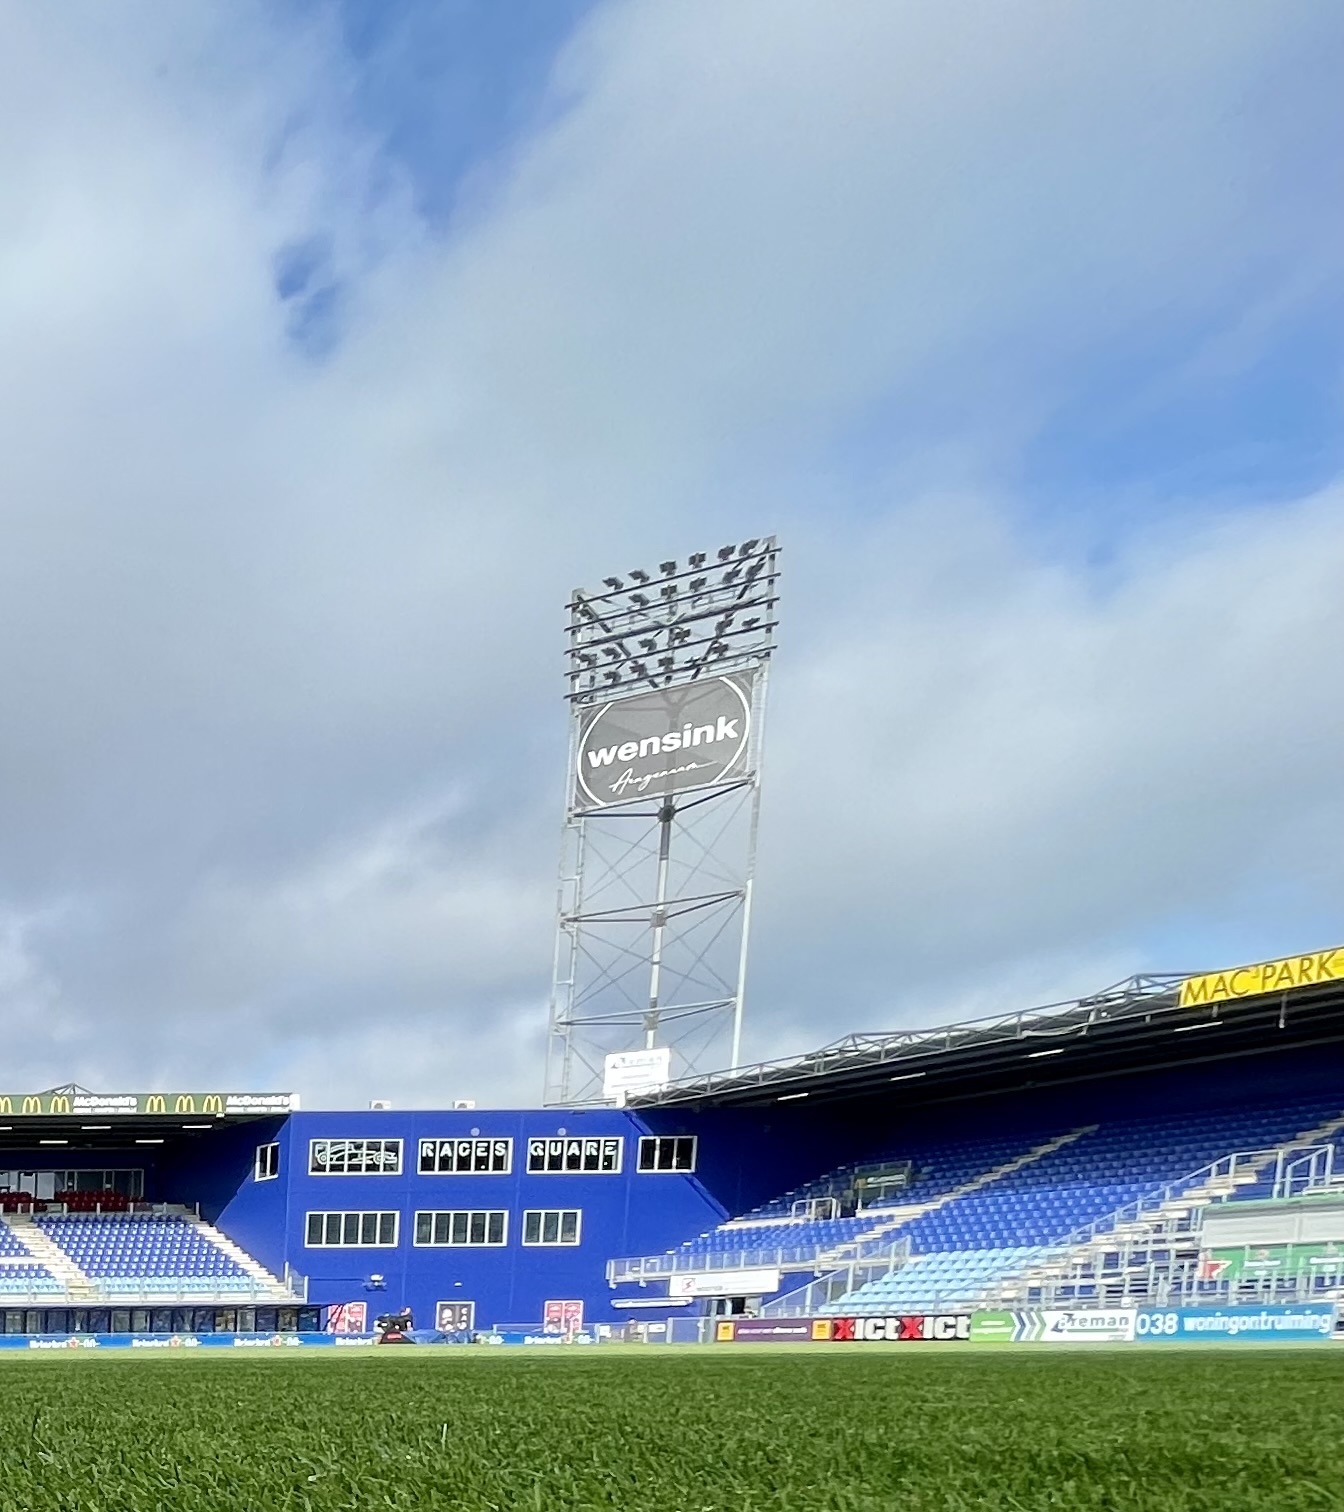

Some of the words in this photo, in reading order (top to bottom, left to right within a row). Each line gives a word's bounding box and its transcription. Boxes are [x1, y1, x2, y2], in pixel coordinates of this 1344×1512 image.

[587, 715, 739, 769] wensink
[1137, 1312, 1179, 1335] 038
[1183, 1309, 1332, 1335] woningontruiming
